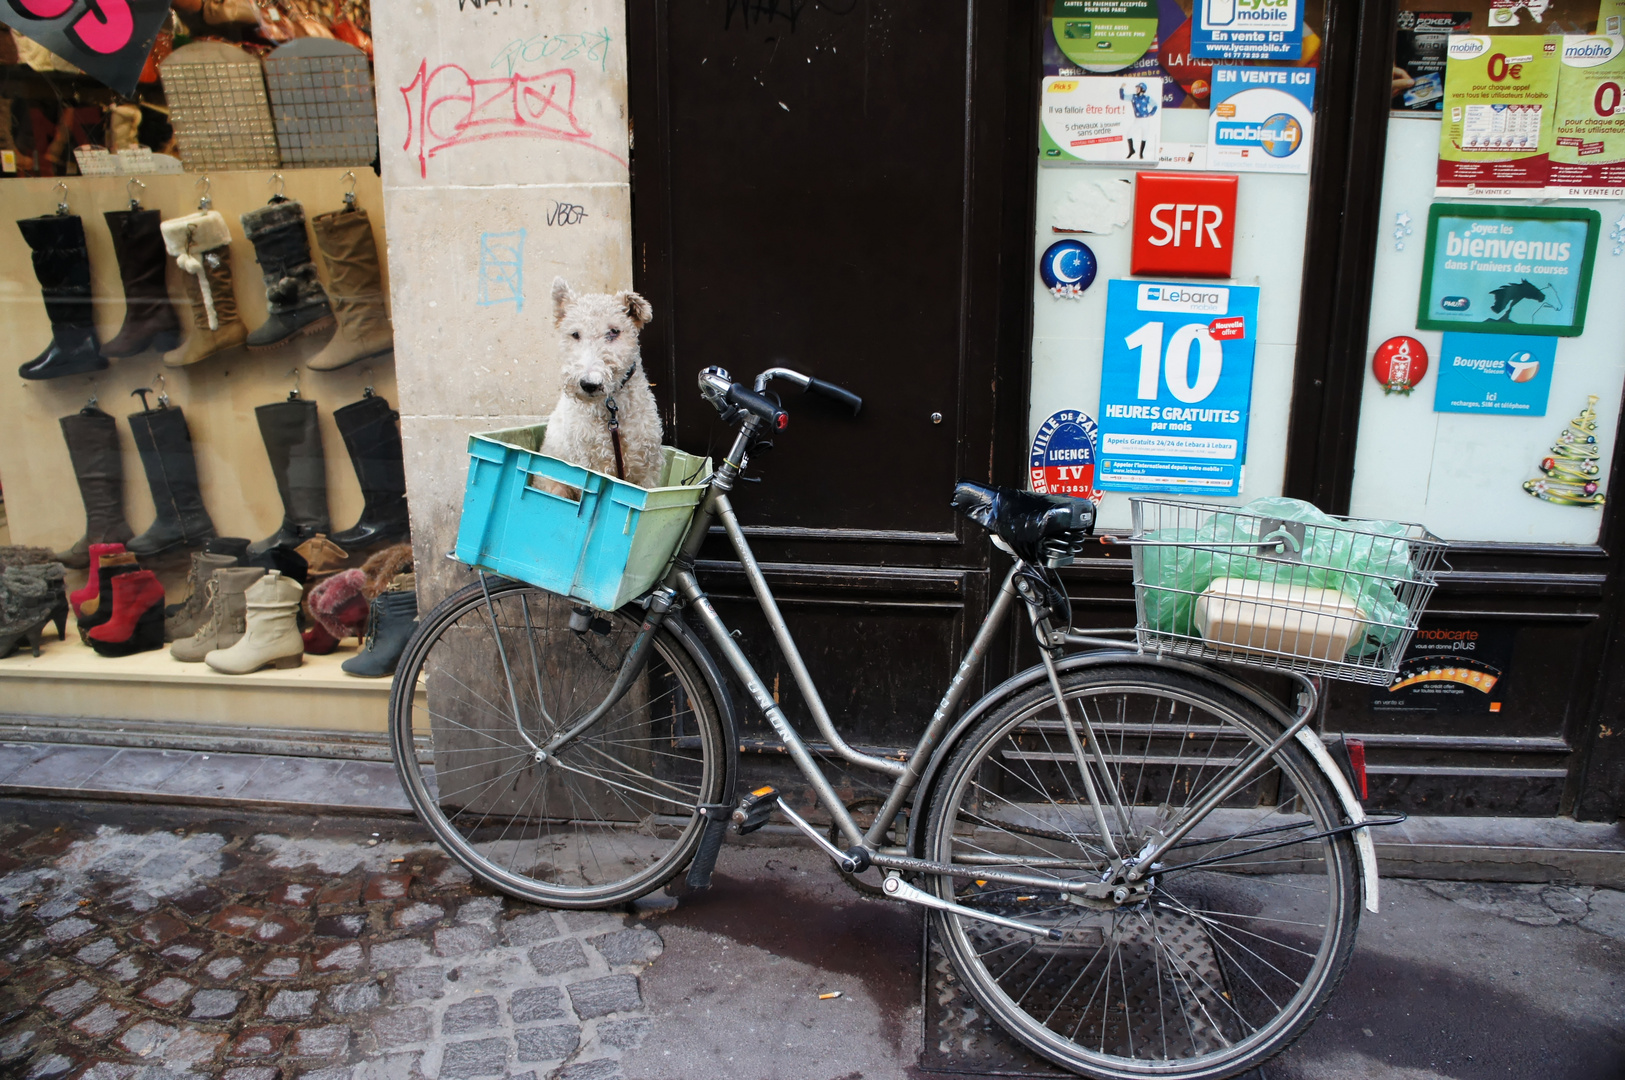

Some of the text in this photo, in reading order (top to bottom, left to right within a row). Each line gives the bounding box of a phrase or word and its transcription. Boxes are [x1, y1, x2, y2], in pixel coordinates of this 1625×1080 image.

[1238, 8, 1288, 20] mobile
[1212, 31, 1284, 42] En vente ici
[1206, 43, 1290, 53] www.lycamobile.fr
[1450, 41, 1484, 52] mobiho
[1565, 45, 1612, 56] mobiho
[1168, 53, 1183, 66] LA
[1217, 70, 1311, 85] EN VENTE ICI
[1490, 84, 1511, 92] chaque
[1512, 84, 1530, 92] appel
[1064, 106, 1084, 114] falloir
[1086, 105, 1103, 114] être
[1105, 105, 1120, 114] fort
[1071, 122, 1099, 130] chevaux
[1584, 118, 1613, 127] chaque
[1077, 127, 1112, 137] sans ordre
[1219, 125, 1297, 142] mobisud
[1148, 203, 1223, 248] SFR
[1471, 222, 1514, 235] Soyez les
[1446, 231, 1571, 262] bienvenus
[1444, 259, 1569, 275] dans l'univers des courses
[1162, 288, 1219, 304] Lebara
[1215, 320, 1243, 329] Nouvelle
[1221, 328, 1237, 336] offre
[1124, 321, 1223, 404] 10
[1453, 356, 1505, 371] Bouygues
[1486, 392, 1497, 401] ici
[1451, 400, 1480, 408] recharges,
[1501, 402, 1530, 410] téléphone
[1105, 404, 1240, 424] HEURES GRATUITES
[1151, 422, 1192, 431] par mois
[1032, 413, 1098, 456] VILLE DE PAR
[1107, 437, 1129, 446] Appels
[1129, 438, 1155, 446] Gratuits
[1156, 439, 1175, 447] 24/24
[1049, 448, 1090, 461] LICENCE
[1057, 465, 1084, 480] IV
[1062, 485, 1088, 493] 13831
[1416, 628, 1479, 641] mobicarte
[1453, 641, 1476, 651] plus
[933, 660, 970, 721] UNION
[747, 680, 793, 743] UNION
